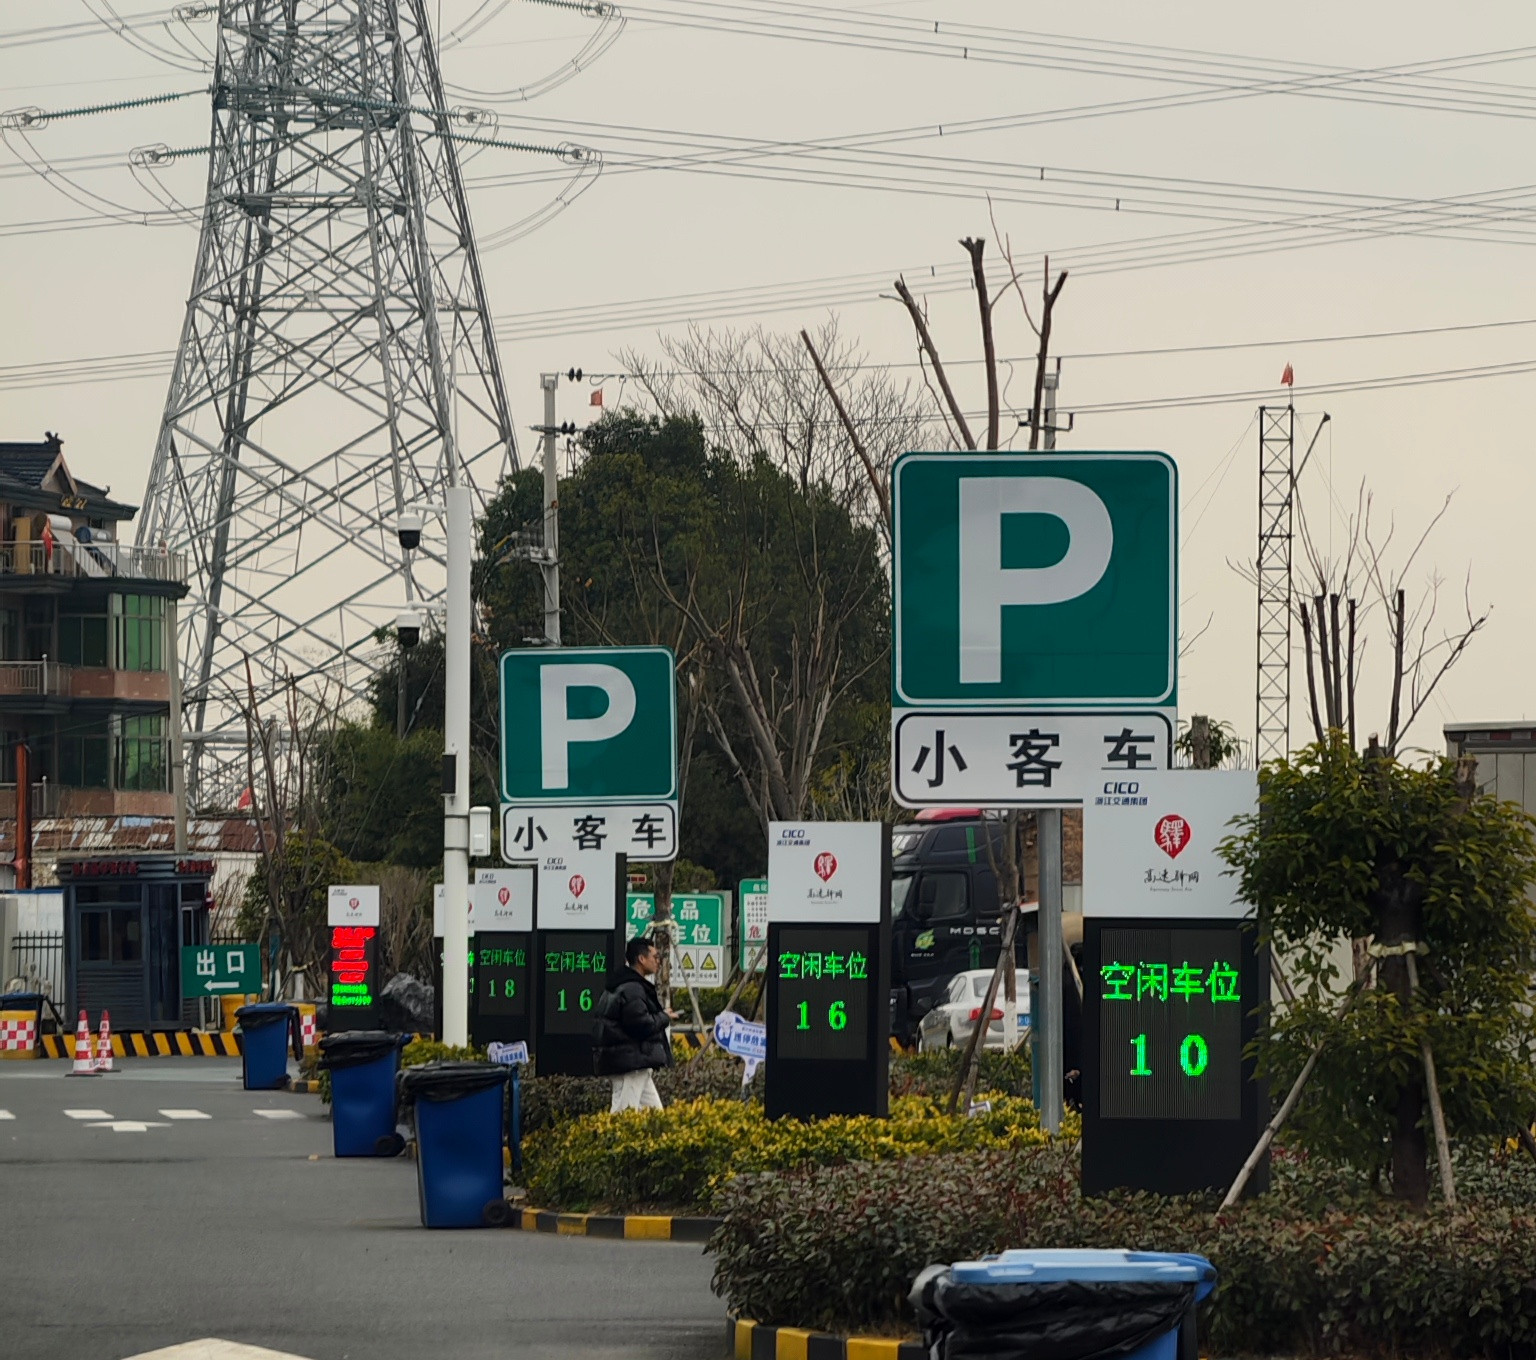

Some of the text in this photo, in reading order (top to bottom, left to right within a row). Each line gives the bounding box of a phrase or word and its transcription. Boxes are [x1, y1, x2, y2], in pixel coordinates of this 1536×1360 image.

[959, 476, 1115, 684] P
[540, 663, 637, 791] P
[912, 727, 1158, 789] 小客车
[1094, 796, 1149, 806] 浙江交通集团
[1103, 781, 1140, 795] CICO
[513, 813, 668, 852] 小客车
[631, 898, 700, 921] 危品
[196, 949, 245, 977] 出口
[480, 949, 526, 967] 空闲车位
[545, 951, 607, 973] 空闲车位
[778, 950, 869, 980] 空闲车位
[1100, 960, 1241, 1004] 空闲车位
